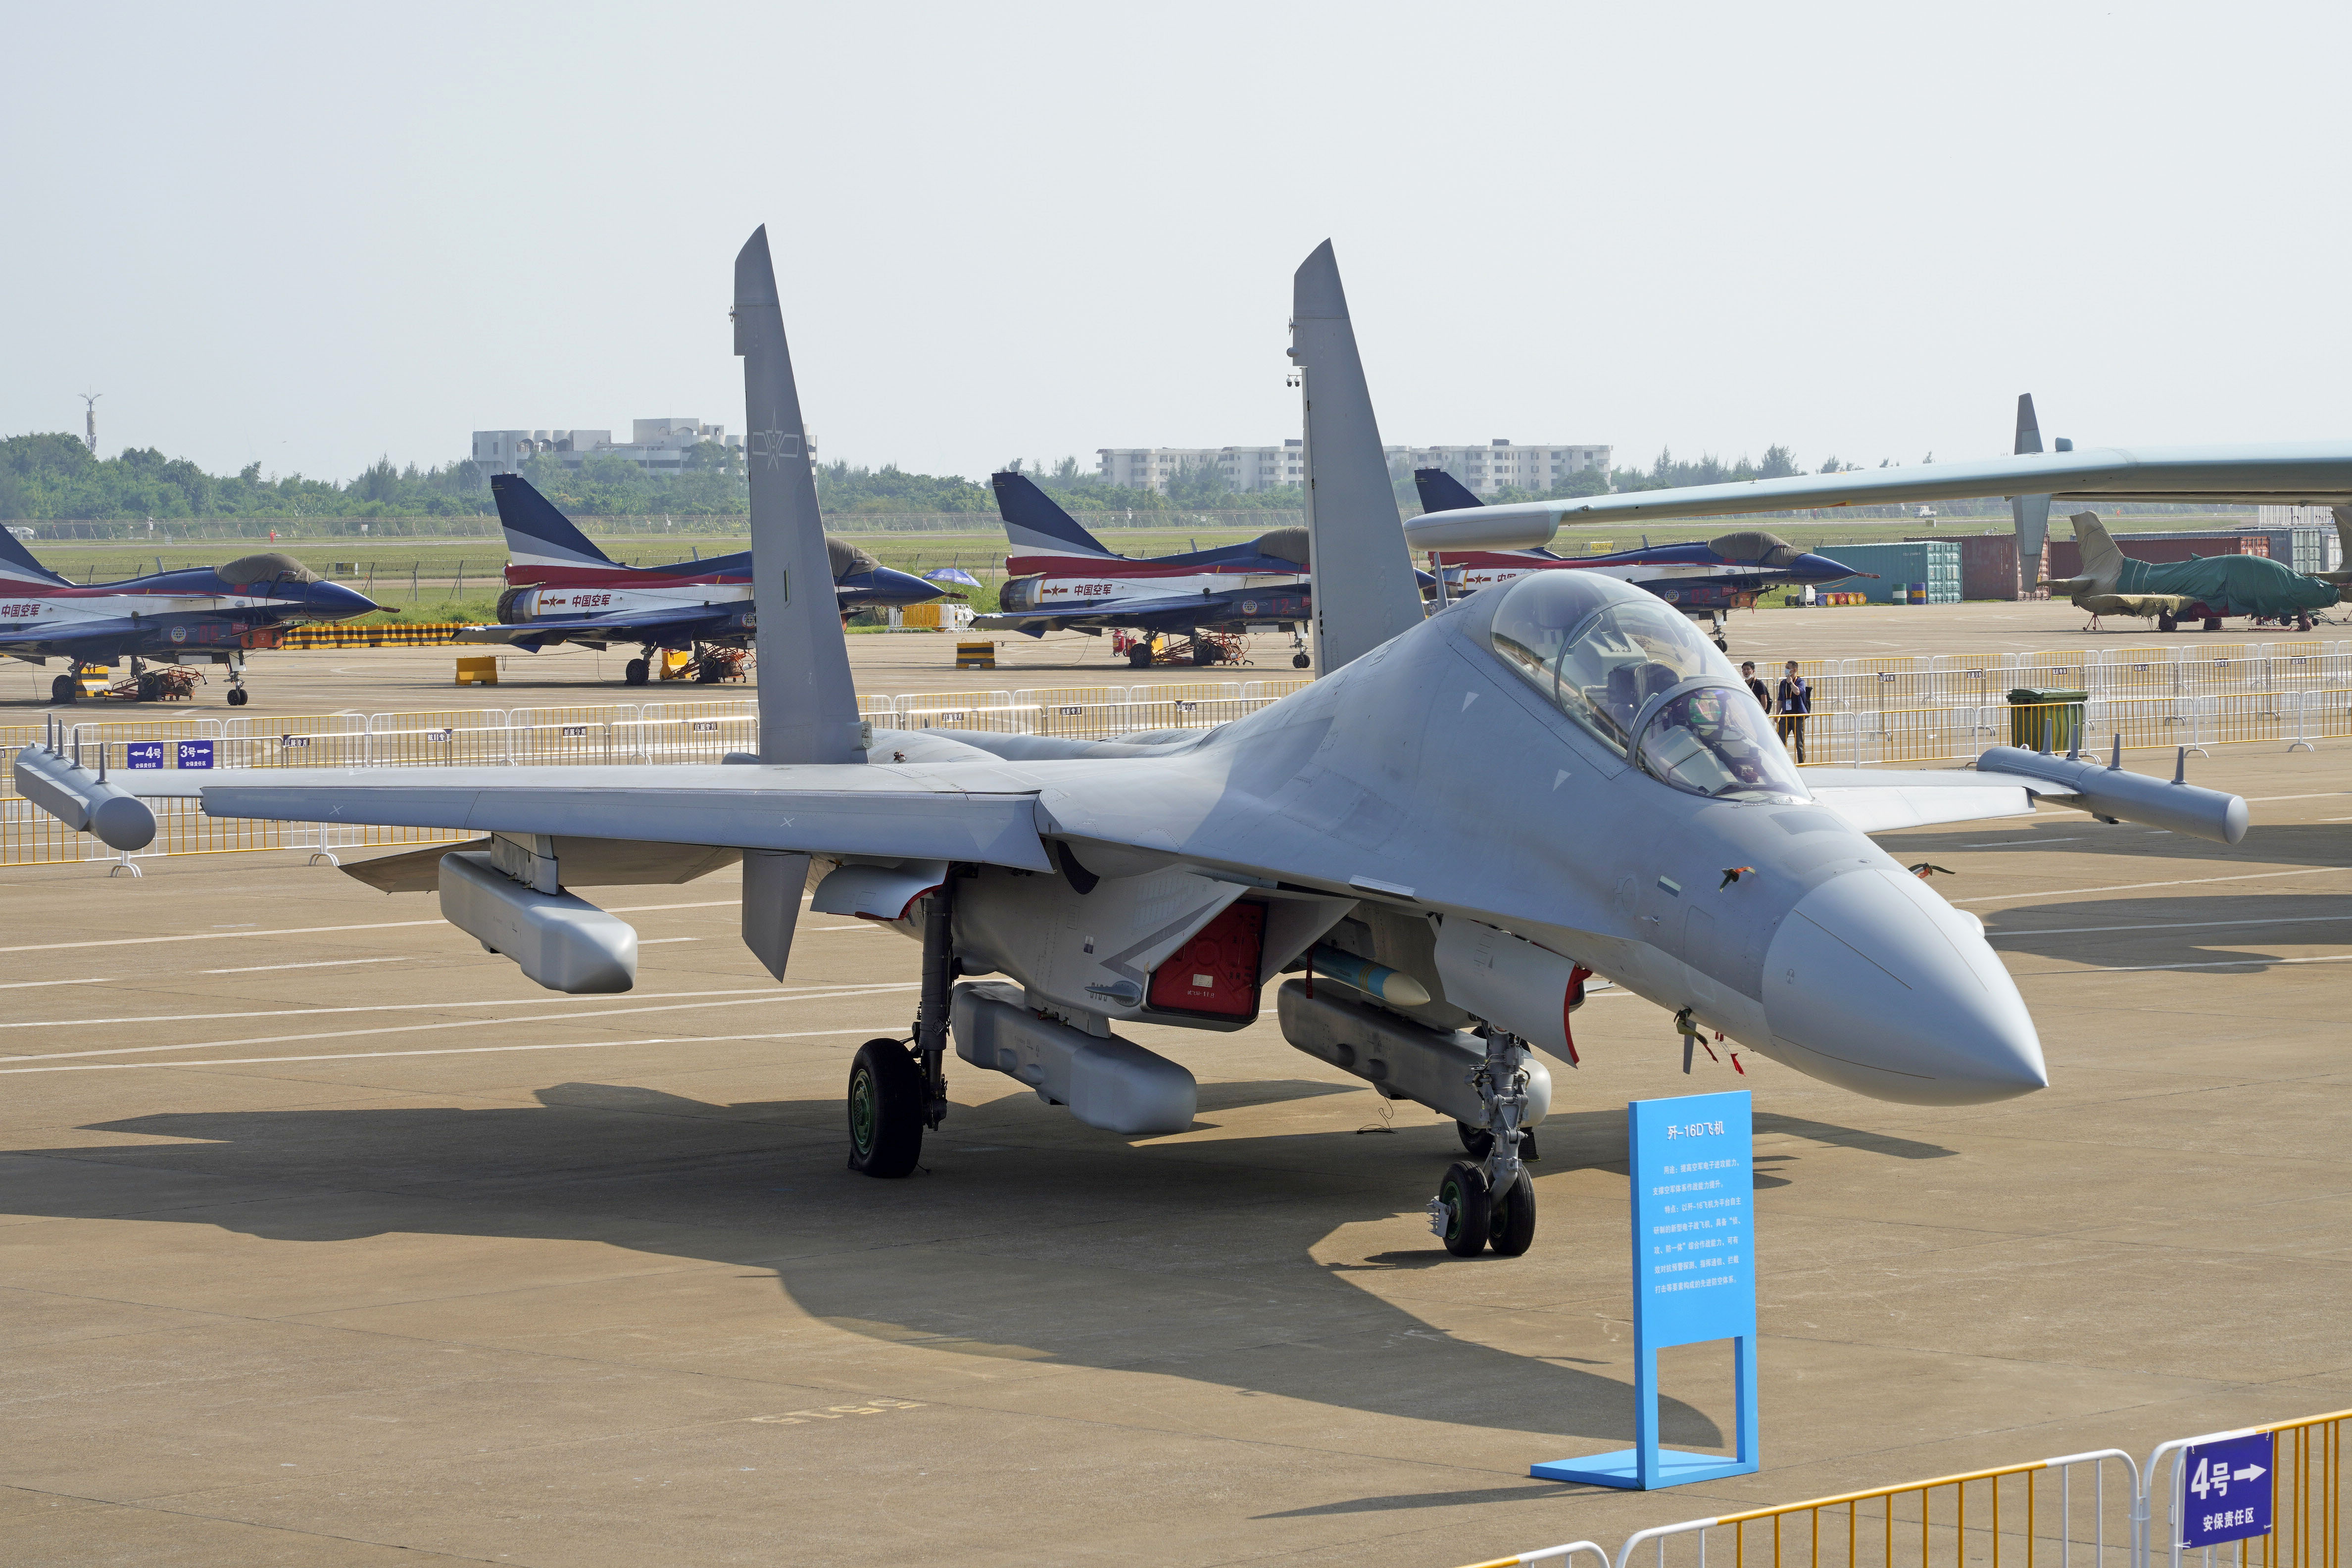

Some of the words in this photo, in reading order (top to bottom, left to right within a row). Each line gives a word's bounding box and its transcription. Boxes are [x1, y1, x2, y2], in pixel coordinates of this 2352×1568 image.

[1074, 584, 1113, 596] 中国空军
[1691, 589, 1710, 603] 02
[572, 594, 611, 607] 中国空军
[1272, 598, 1289, 614] 12
[1, 604, 41, 617] 中国空军
[146, 746, 161, 758] 4号
[180, 745, 196, 758] 3号
[1667, 1121, 1724, 1140] 歼-16D飞机
[2191, 1458, 2230, 1500] 4号
[2203, 1507, 2254, 1532] 安保责任区
